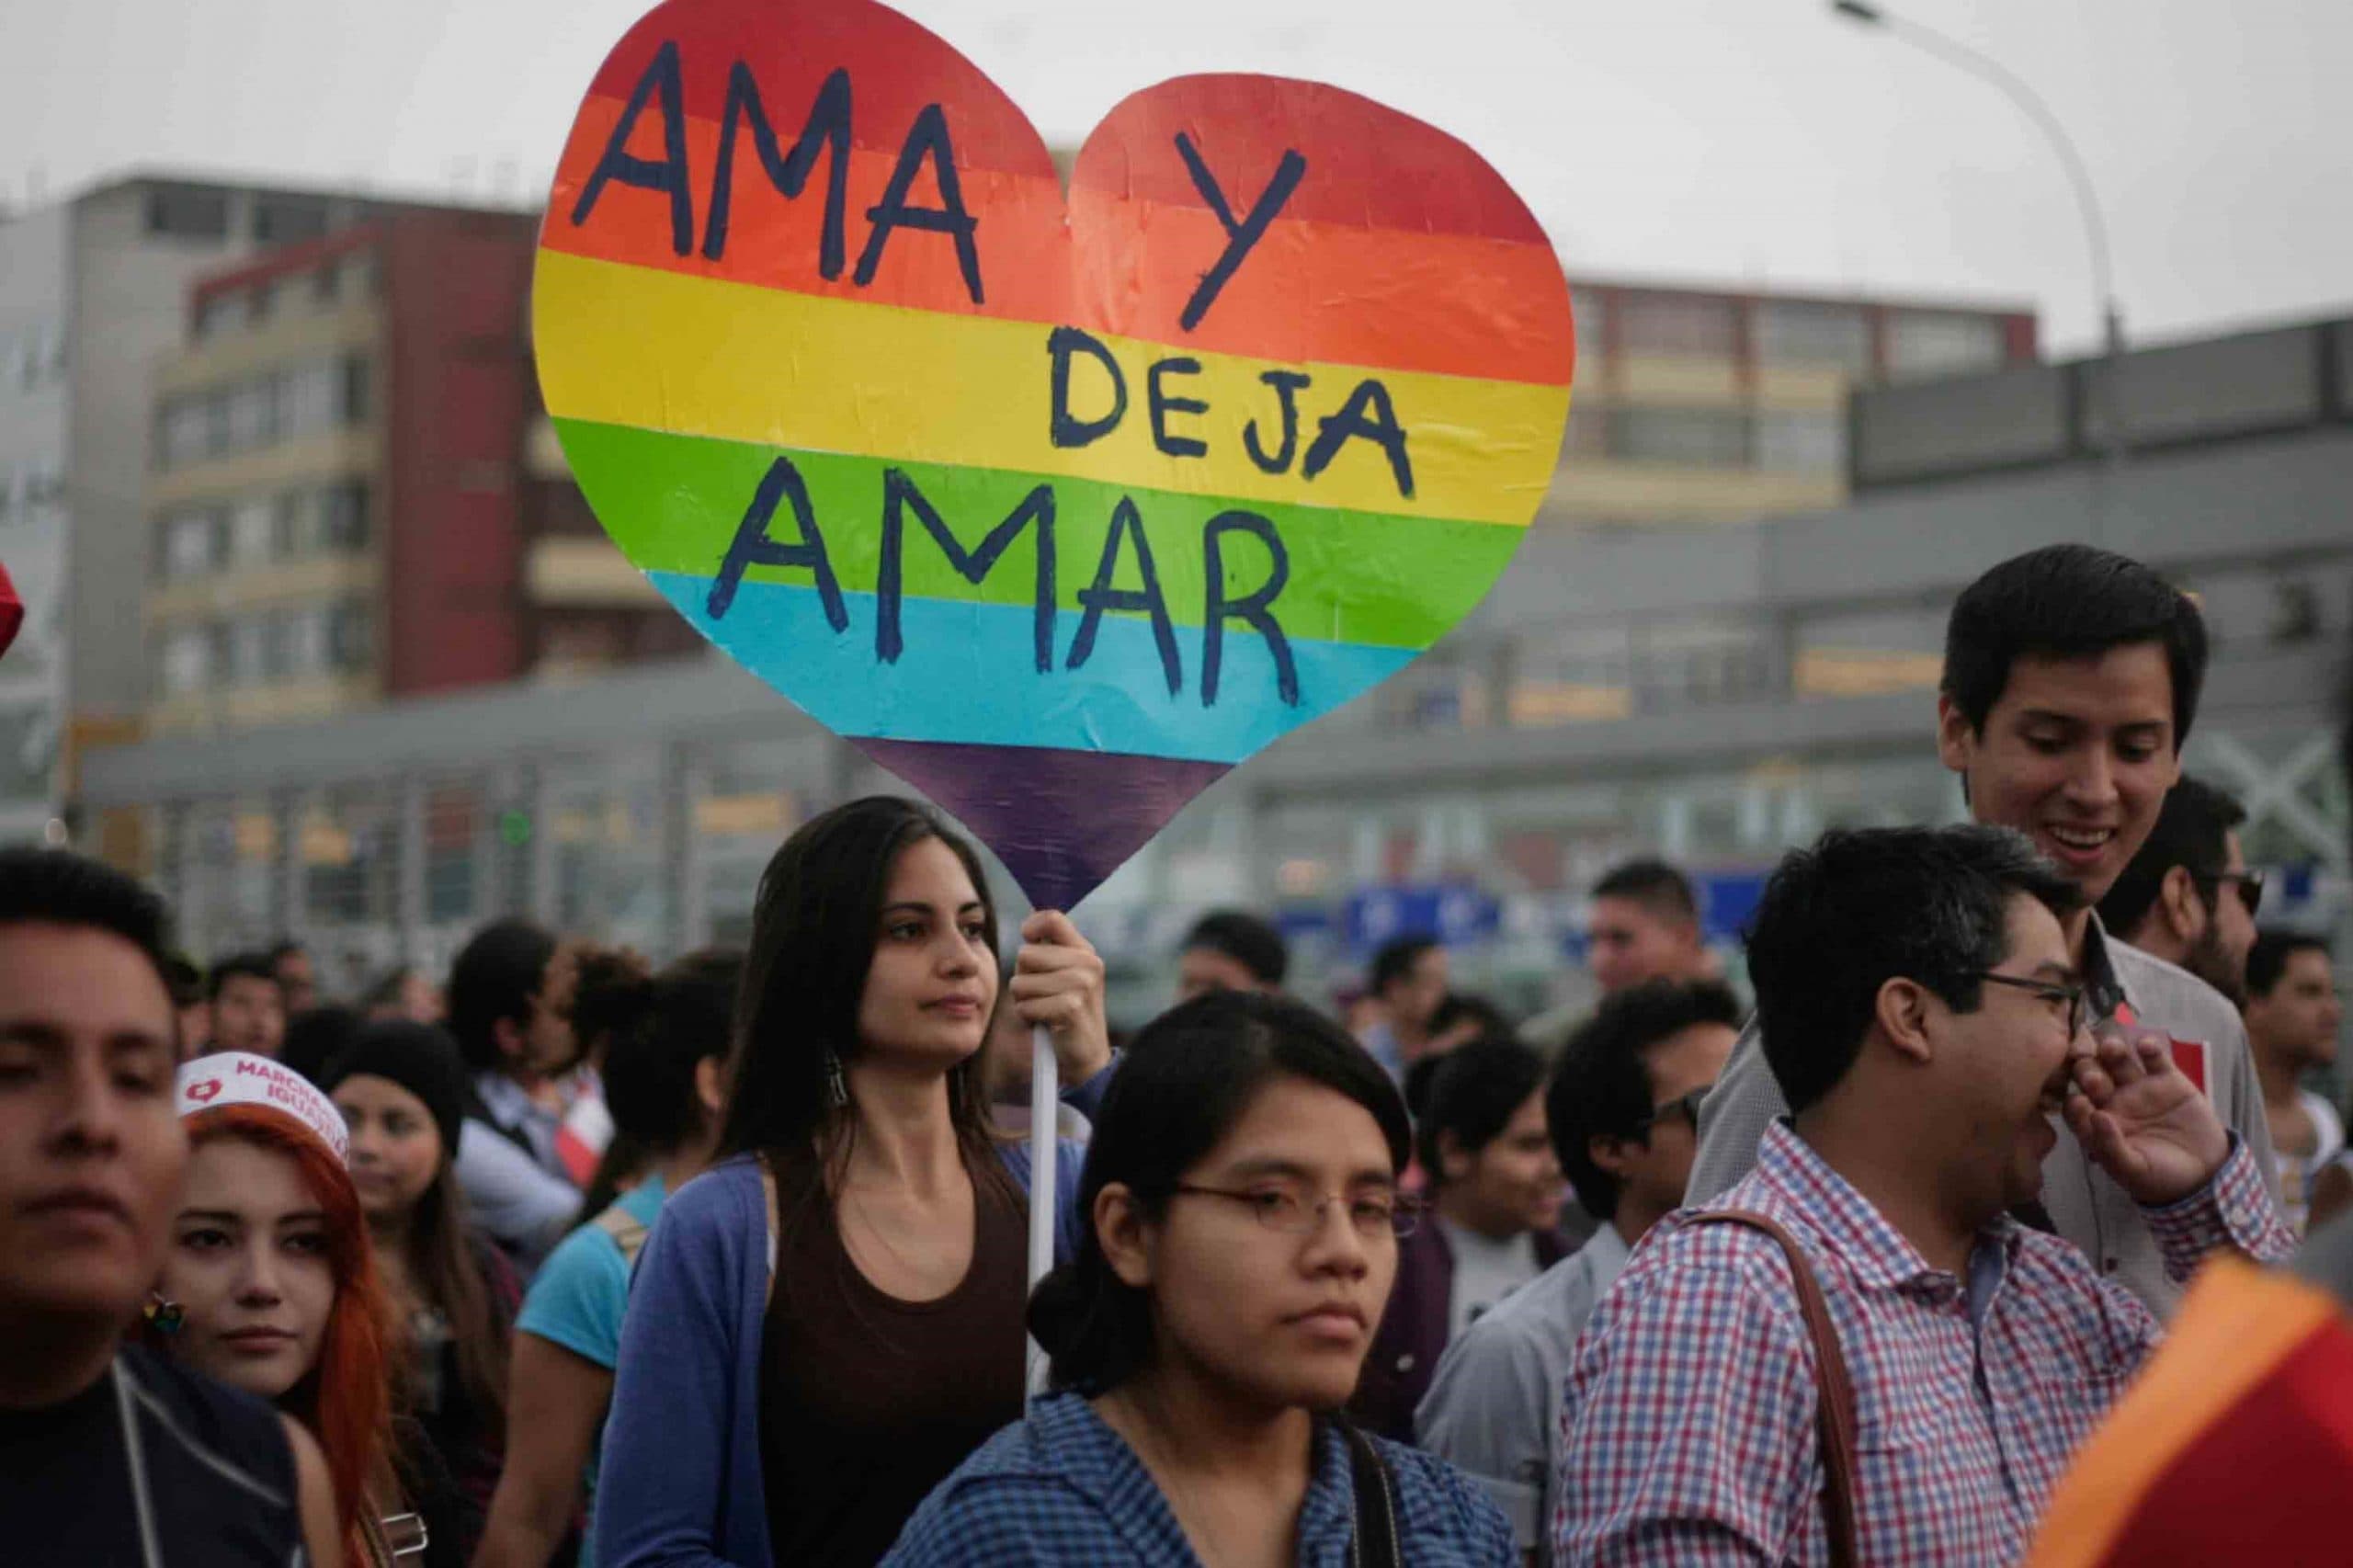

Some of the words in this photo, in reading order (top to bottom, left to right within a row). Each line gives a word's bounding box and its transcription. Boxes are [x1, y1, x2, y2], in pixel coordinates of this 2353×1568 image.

[571, 40, 984, 304] AMA
[1174, 131, 1307, 331] Y
[1046, 325, 1415, 499] DEJA
[706, 456, 1300, 707] AMAR
